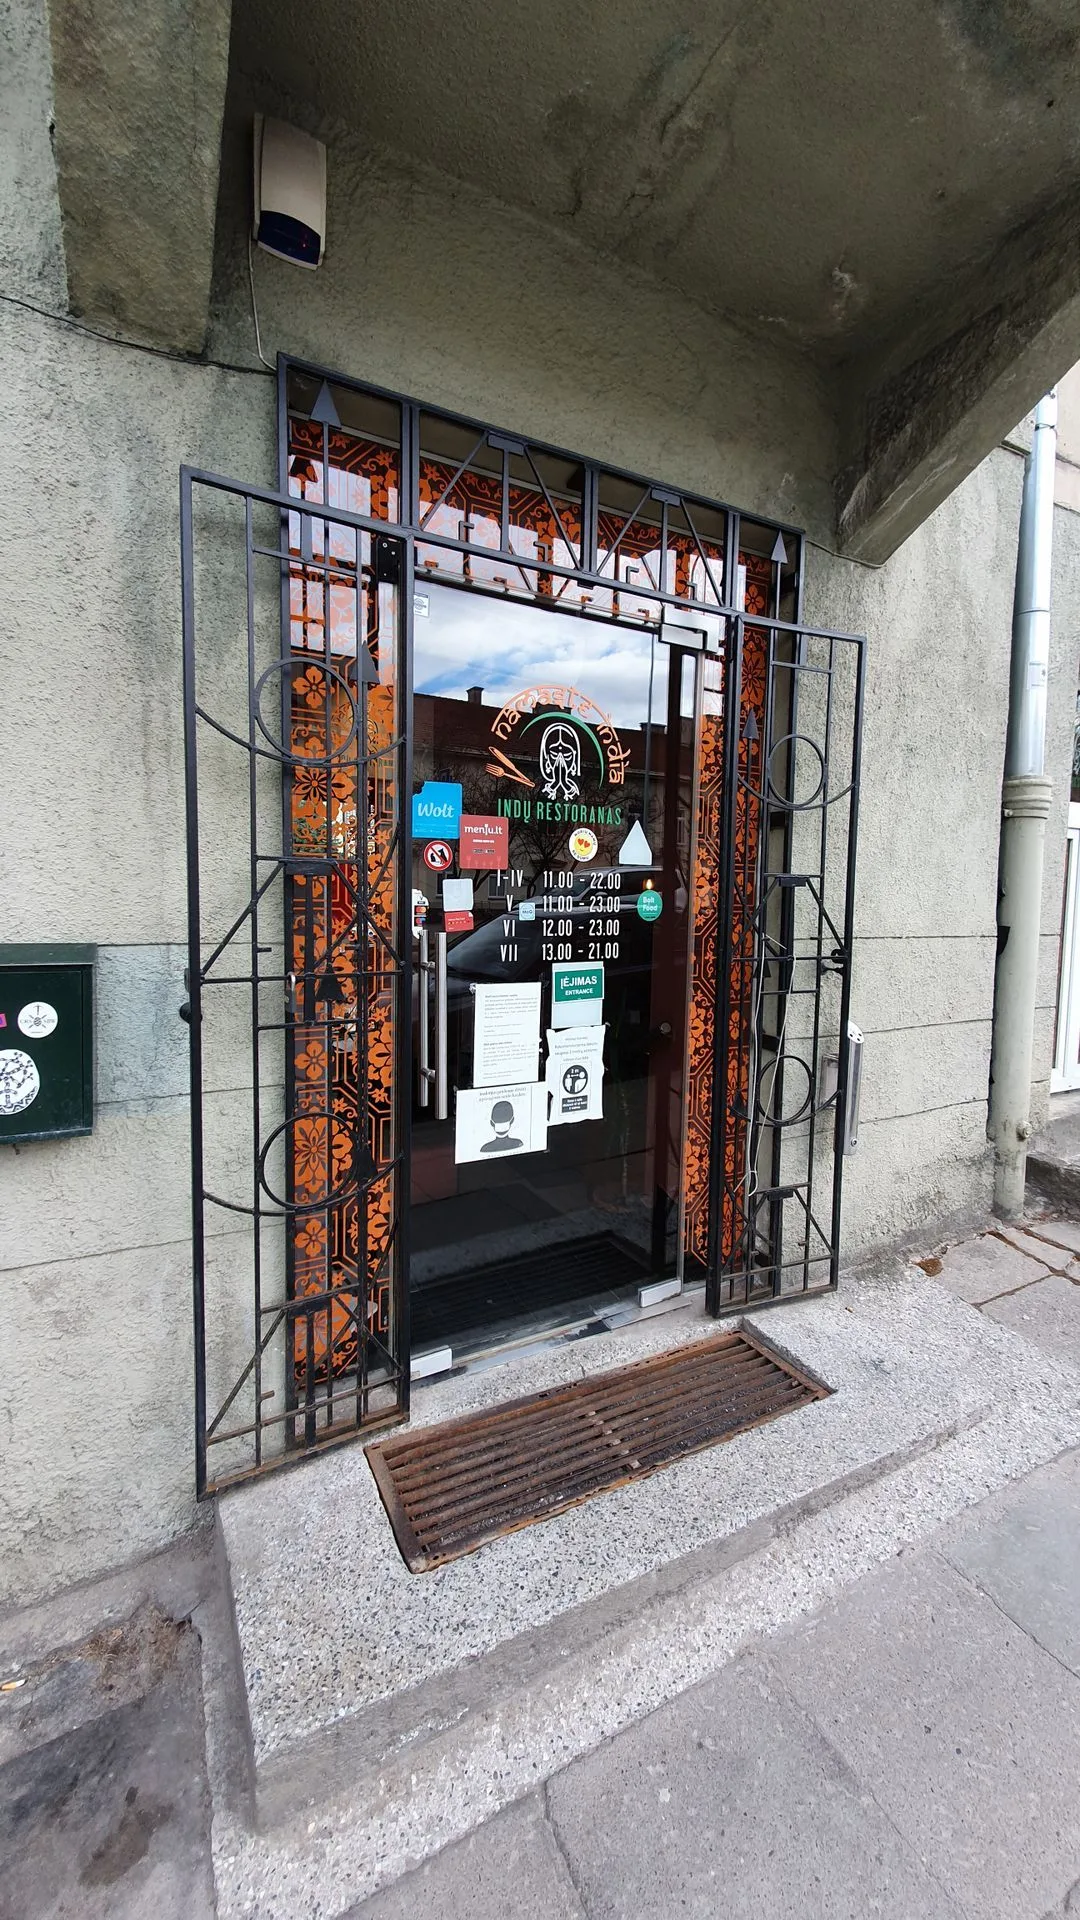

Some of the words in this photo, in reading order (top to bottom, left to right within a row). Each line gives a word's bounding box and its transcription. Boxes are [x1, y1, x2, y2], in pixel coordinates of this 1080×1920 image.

[417, 802, 455, 818] Wolt
[498, 798, 531, 823] INDŲ
[537, 801, 622, 825] RESTORANAS
[543, 870, 573, 888] 11.00
[590, 872, 621, 889] 22.00
[506, 894, 514, 912] V
[542, 895, 573, 912] 11.00
[589, 896, 620, 913] 23.00
[642, 904, 658, 912] Food
[503, 919, 516, 937] VI
[542, 919, 573, 937] 12.00
[588, 919, 620, 936] 23.00
[500, 944, 518, 962] VII
[541, 943, 572, 961] 13.00
[588, 942, 619, 960] 21.00
[560, 975, 598, 990] ĮĖJIMAS
[564, 988, 594, 996] ENTRANCE
